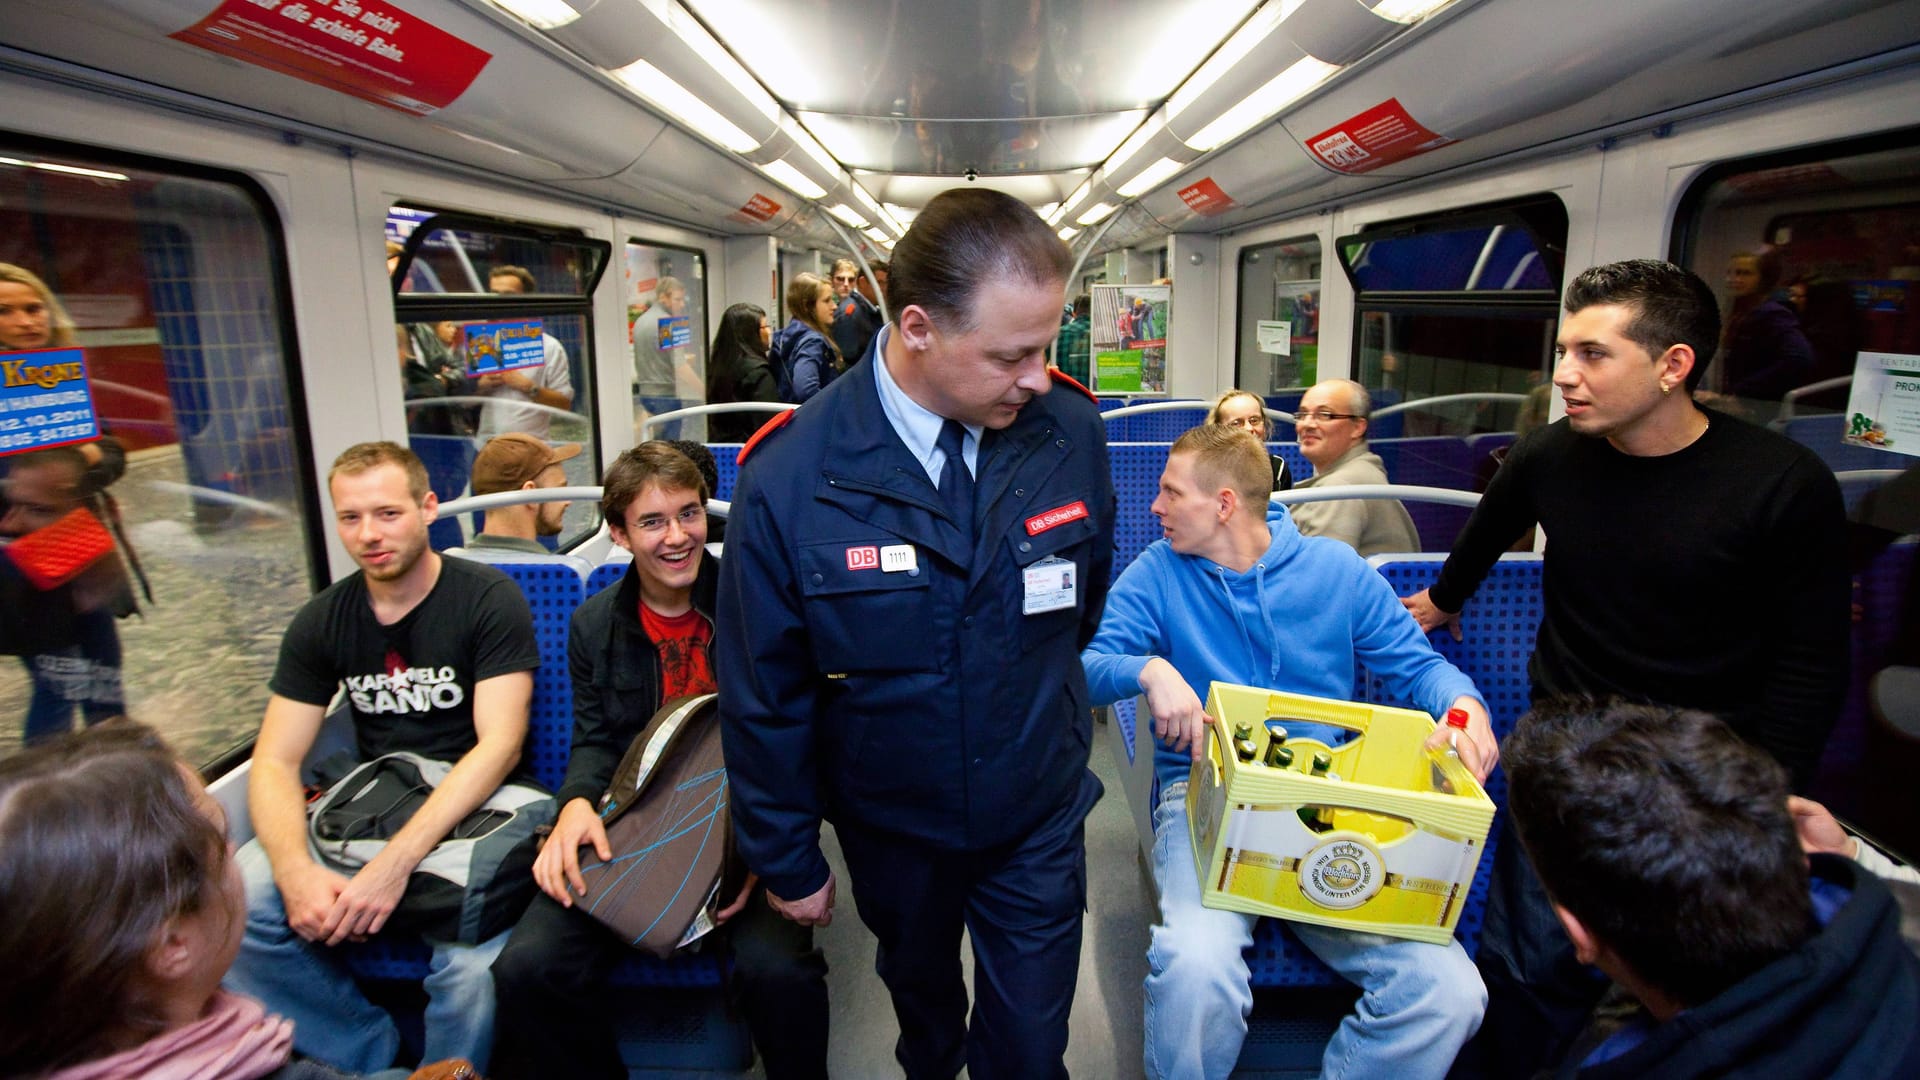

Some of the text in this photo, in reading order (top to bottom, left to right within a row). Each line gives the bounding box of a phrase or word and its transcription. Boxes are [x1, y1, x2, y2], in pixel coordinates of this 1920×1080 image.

[280, 3, 312, 23] die
[309, 17, 368, 47] schiefe
[359, 11, 401, 35] nicht
[1, 360, 82, 388] KRONE
[850, 549, 875, 566] DB
[889, 551, 908, 564] 1111
[1324, 889, 1351, 899] UNTER
[1350, 883, 1366, 896] DEN
